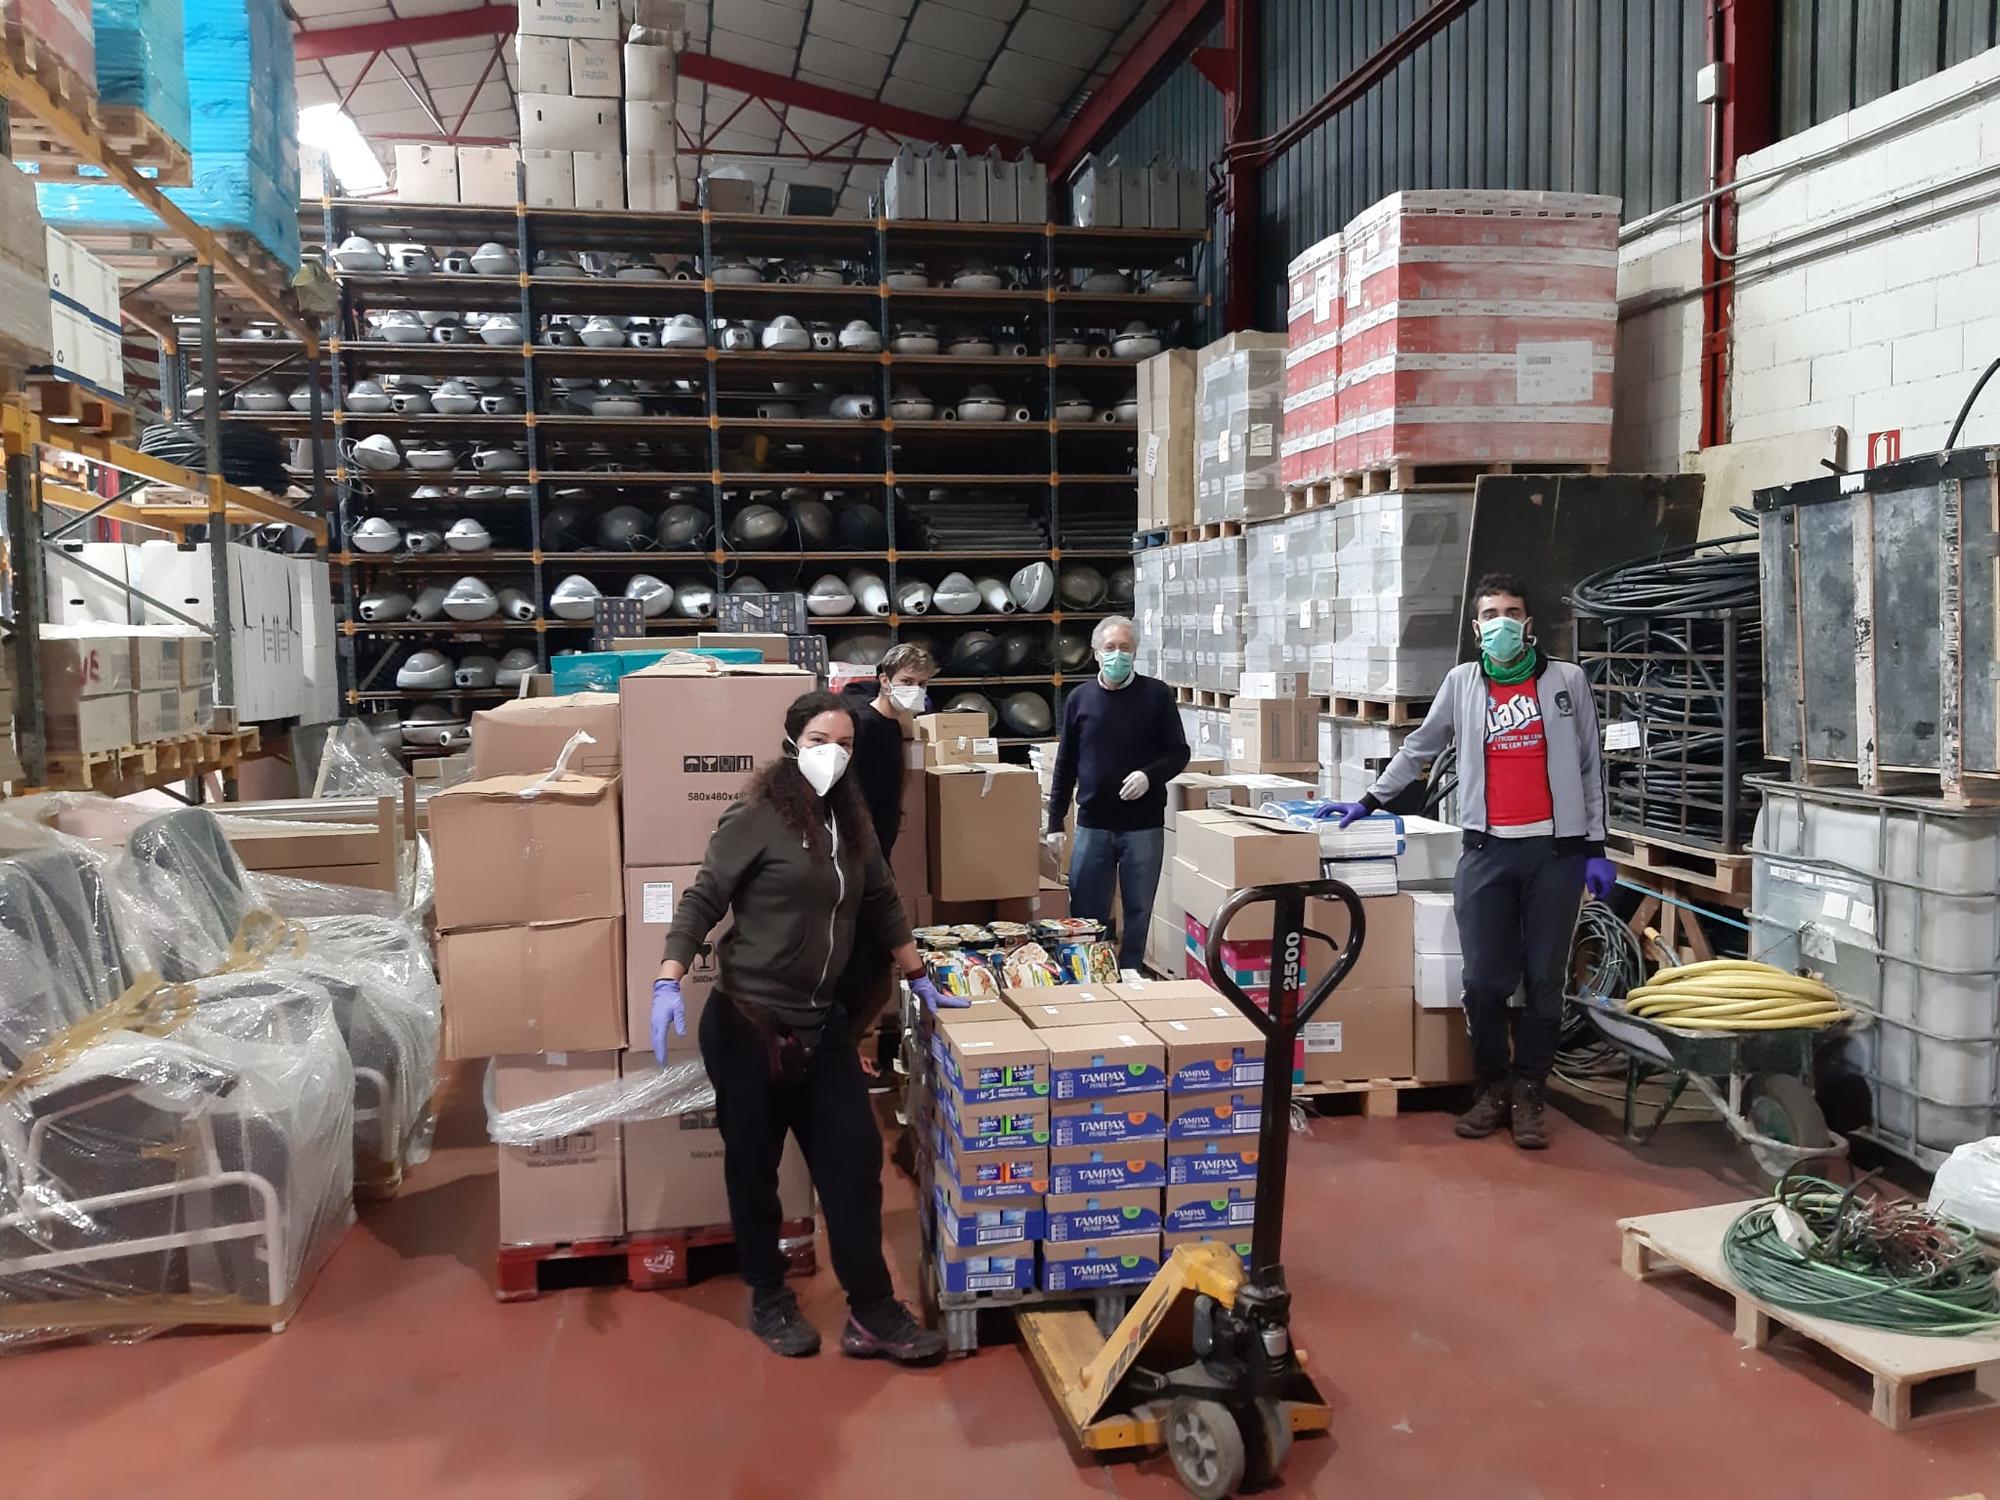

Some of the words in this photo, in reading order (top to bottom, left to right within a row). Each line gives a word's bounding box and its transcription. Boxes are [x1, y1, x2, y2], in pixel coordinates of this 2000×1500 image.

[1283, 931, 1300, 991] 2500
[1080, 1071, 1126, 1083] TAMPAX
[1178, 1069, 1210, 1078] TAMPAX
[1079, 1120, 1126, 1132] TAMPAX
[1178, 1116, 1210, 1125] TAMPAX
[1193, 1159, 1238, 1170] TAMPAX
[1078, 1168, 1125, 1180] TAMPAX
[1174, 1208, 1206, 1217] TAMPAX
[1073, 1214, 1120, 1227] TAMPAX
[1072, 1263, 1118, 1276] TAMPAX
